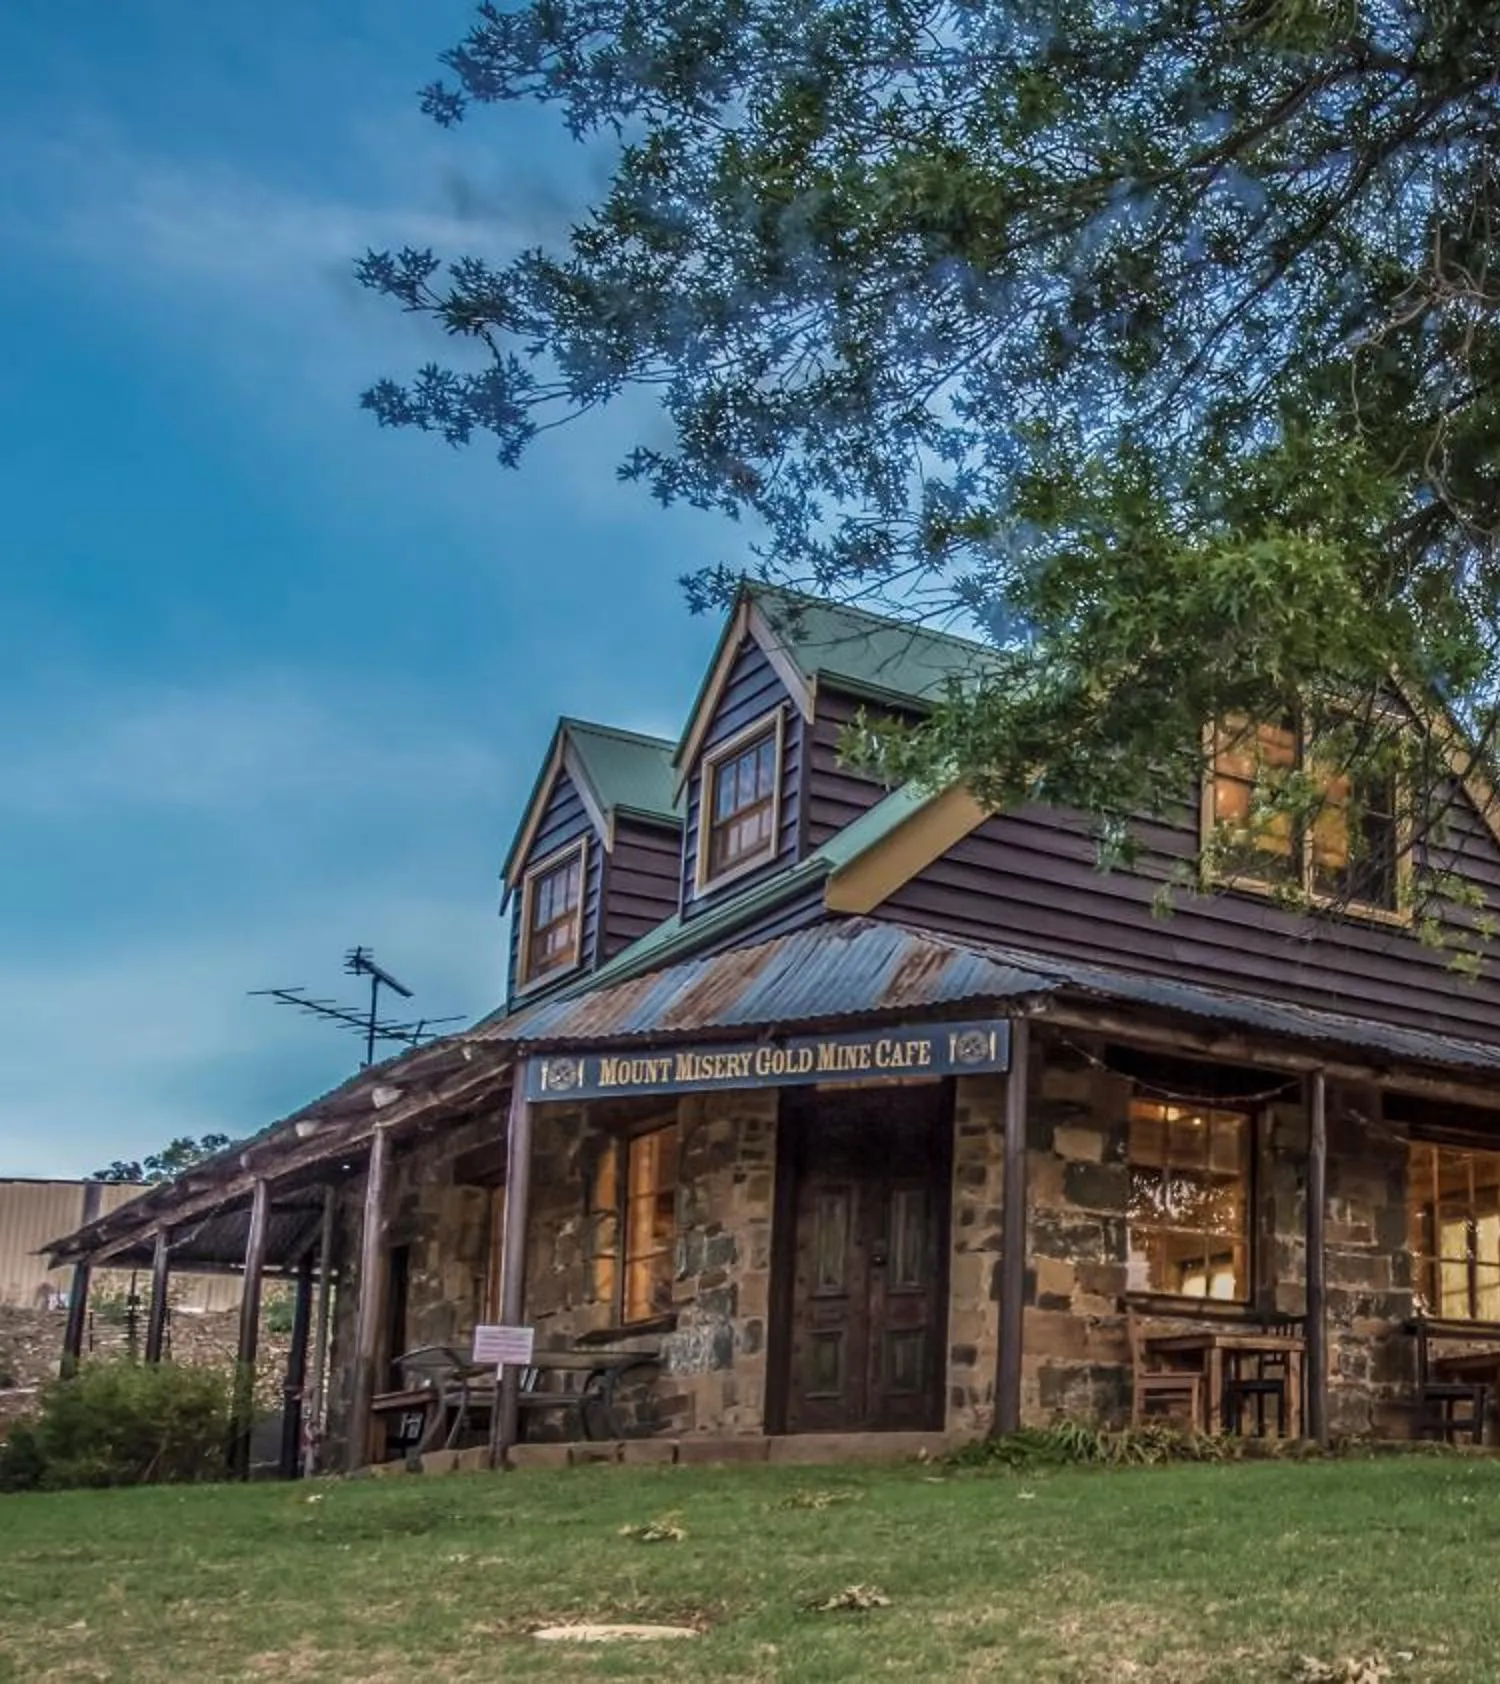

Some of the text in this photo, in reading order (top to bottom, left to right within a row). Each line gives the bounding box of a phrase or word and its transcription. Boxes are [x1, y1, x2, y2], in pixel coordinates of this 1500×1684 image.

[598, 1039, 931, 1086] MOUNT MISERY GOLD MINE CAFE
